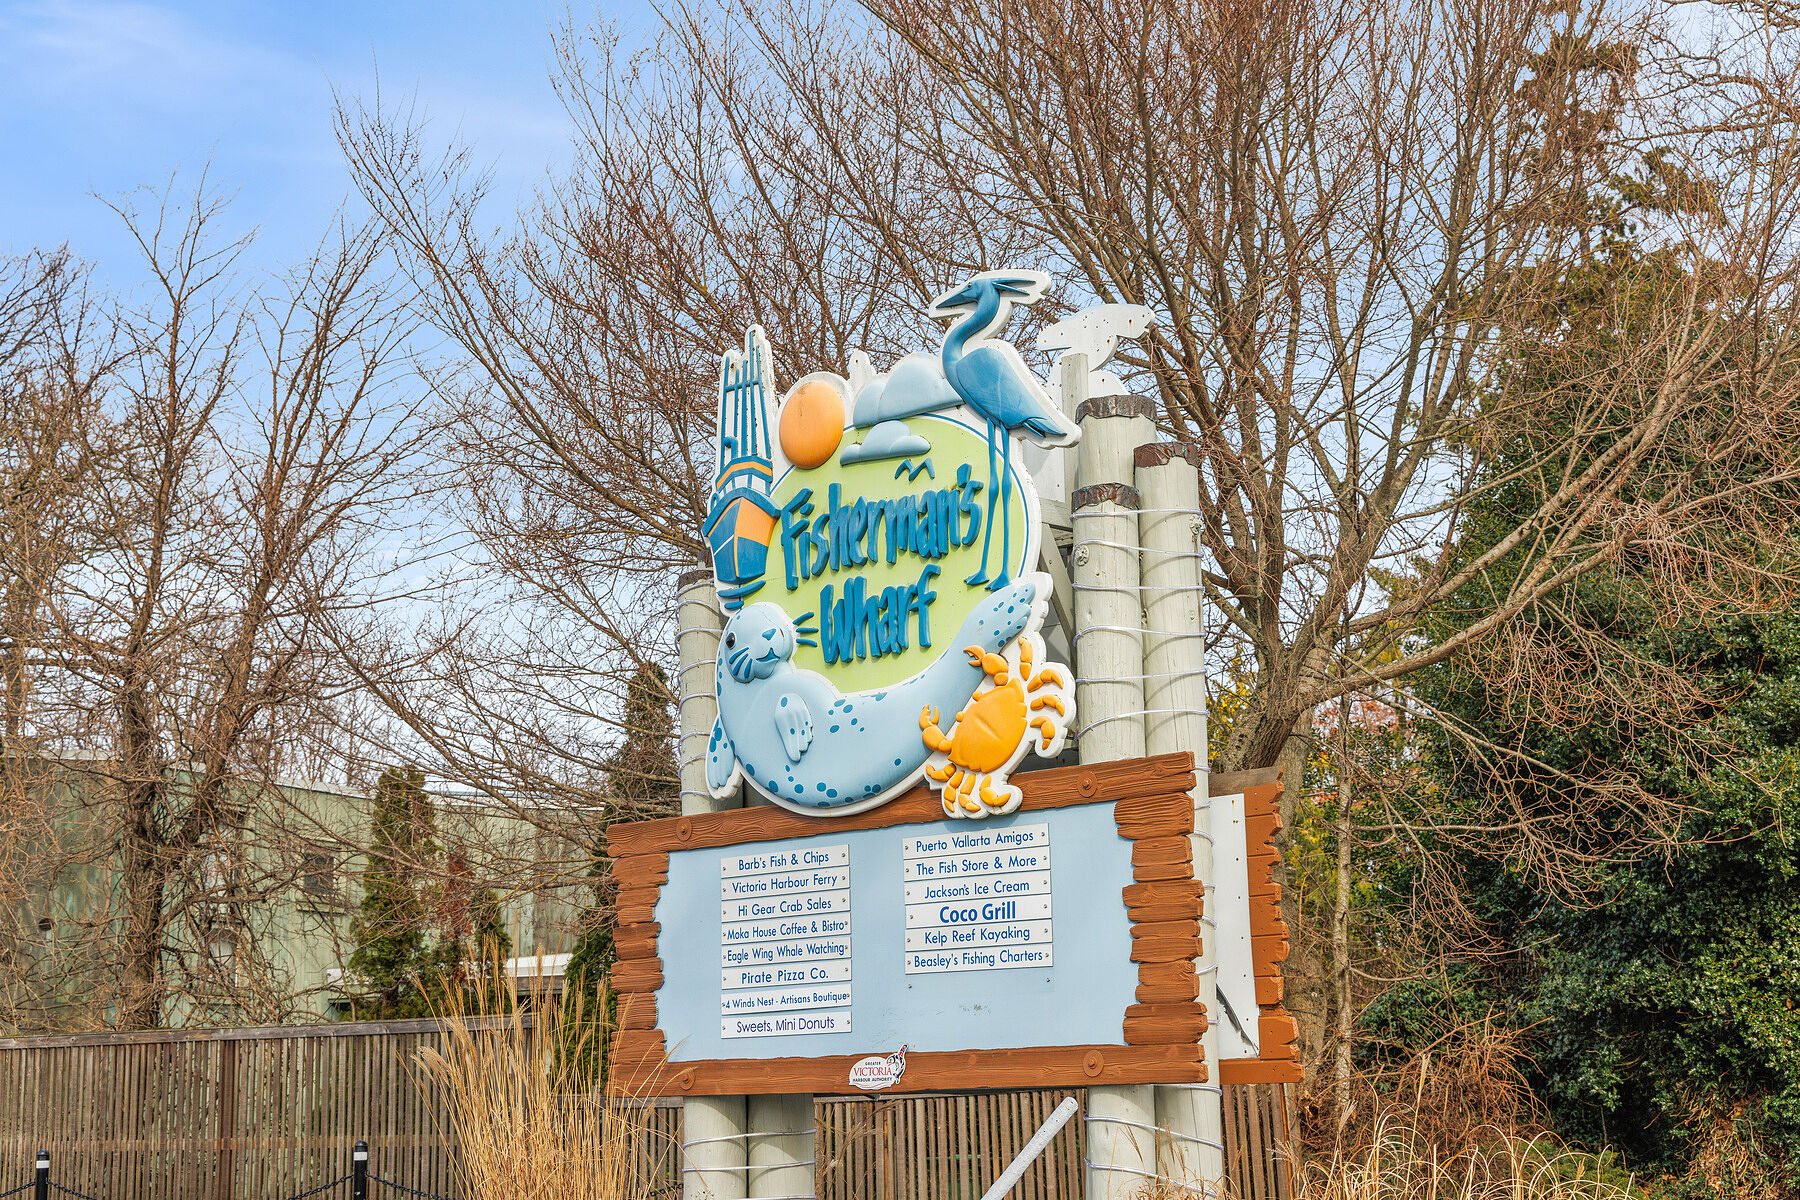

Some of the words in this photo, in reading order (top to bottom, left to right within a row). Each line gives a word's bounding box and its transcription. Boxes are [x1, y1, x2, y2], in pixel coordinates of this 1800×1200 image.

[781, 463, 984, 591] Fisherman's
[820, 564, 941, 665] Wharf
[916, 840, 948, 852] Puerto
[952, 835, 990, 848] Vallarta
[995, 831, 1034, 845] Amigos
[739, 858, 766, 870] Barb's
[770, 855, 786, 867] Fish
[791, 854, 798, 865] &
[804, 852, 829, 865] Chips
[916, 864, 934, 875] The
[939, 860, 957, 873] Fish
[962, 860, 988, 872] Store
[994, 856, 1002, 869] &
[1009, 856, 1036, 868] More
[732, 880, 766, 893] Victoria
[771, 876, 809, 889] Harbour
[814, 874, 837, 887] Ferry
[925, 884, 970, 898] Jackson's
[974, 883, 989, 895] Ice
[994, 880, 1029, 893] Cream
[738, 905, 748, 916] Hi
[752, 904, 775, 915] Gear
[780, 900, 803, 913] Crab
[807, 898, 831, 910] Sales
[940, 906, 978, 923] Coco
[982, 901, 1016, 920] Grill
[727, 928, 749, 940] Moka
[753, 927, 777, 938] House
[780, 923, 807, 936] Coffee
[811, 921, 817, 933] &
[822, 920, 844, 932] Bistro
[925, 931, 948, 946] Kelp
[952, 929, 975, 942] Reef
[981, 926, 1030, 942] Kayaking
[727, 949, 748, 964] Eagle
[752, 948, 773, 961] Wing
[777, 944, 803, 957] Whale
[806, 942, 844, 955] Watching
[914, 953, 958, 969] Beasley's
[962, 952, 995, 966] Fishing
[1000, 950, 1042, 962] Charters
[742, 972, 772, 984] Pirate
[778, 970, 804, 981] Pizza
[810, 968, 829, 980] Co.
[726, 1000, 730, 1009] 4
[732, 998, 754, 1008] Winds
[757, 997, 774, 1007] Nest
[780, 995, 810, 1005] Artisans
[813, 992, 847, 1003] Boutique
[737, 1020, 773, 1033] Sweets,
[776, 1018, 796, 1031] Mini
[799, 1016, 834, 1030] Donuts
[854, 1067, 892, 1076] VICTORIA
